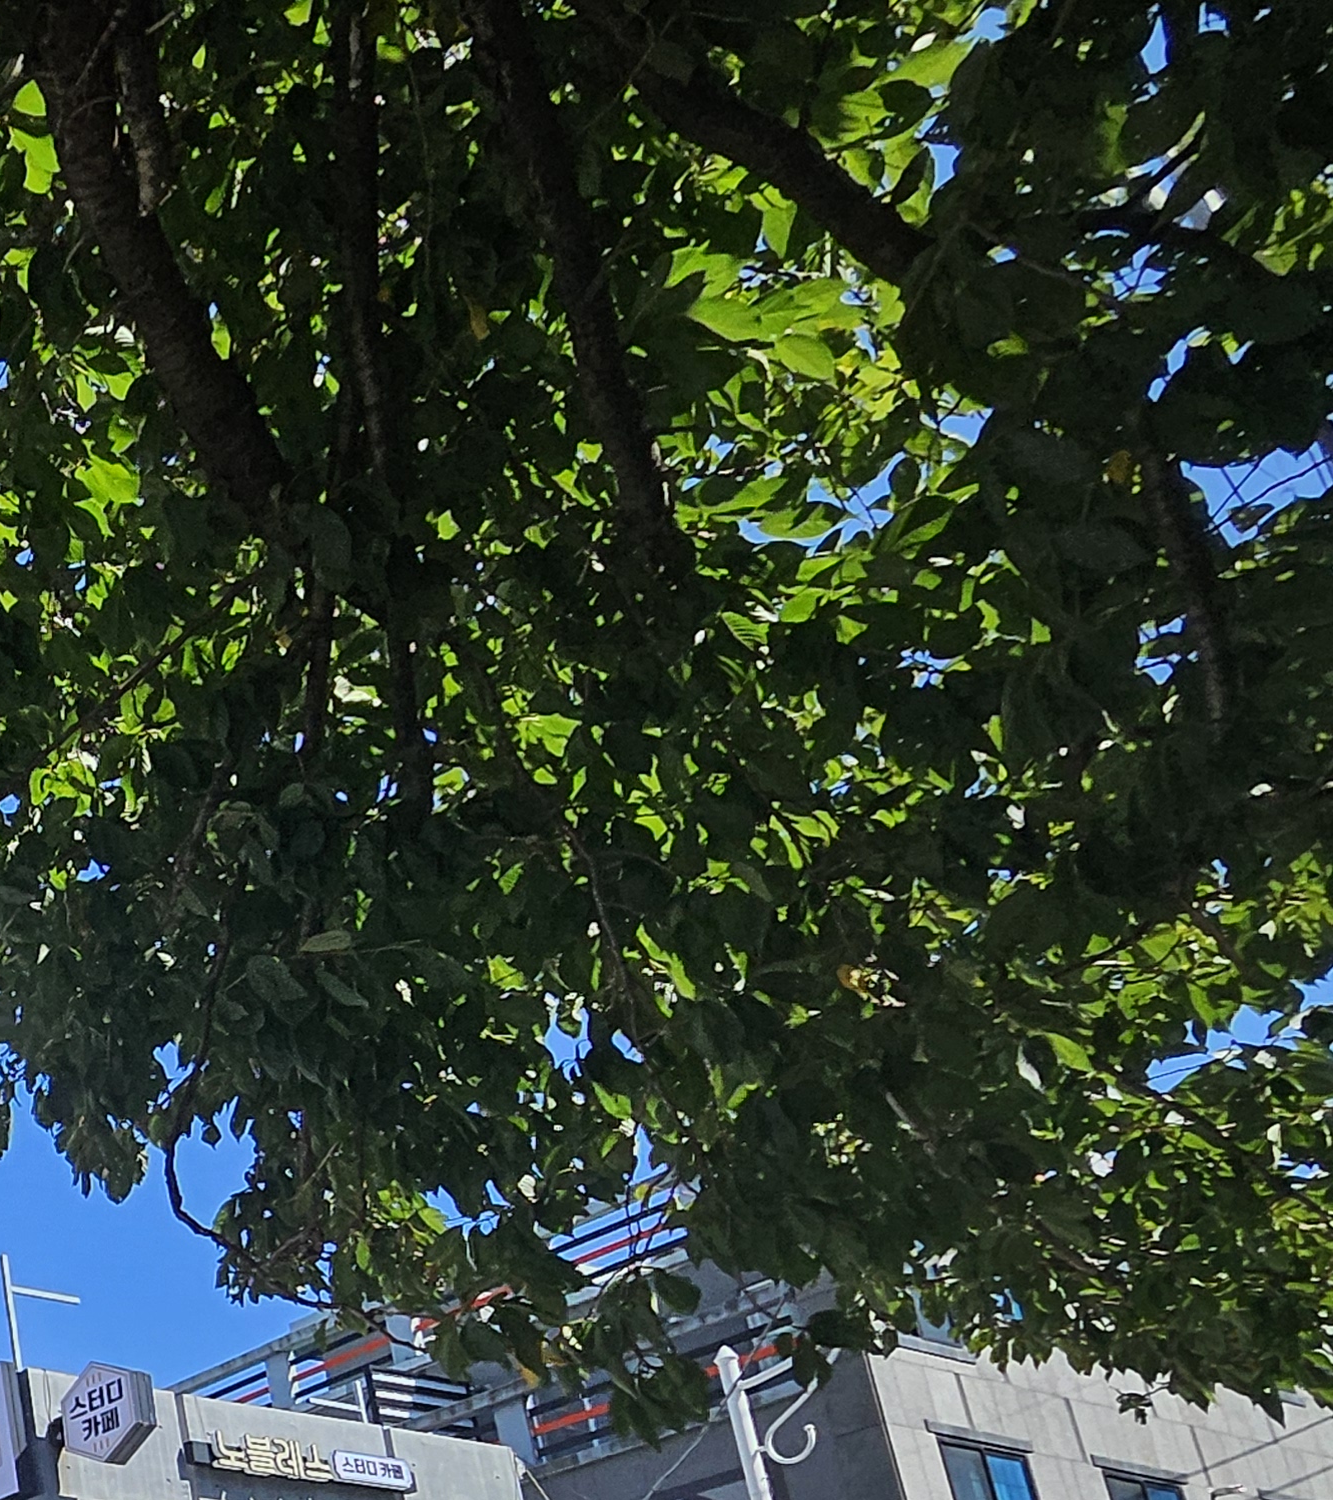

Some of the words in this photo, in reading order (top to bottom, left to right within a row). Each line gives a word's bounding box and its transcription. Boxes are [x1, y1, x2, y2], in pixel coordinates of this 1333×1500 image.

[69, 1377, 124, 1420] 스터디
[81, 1409, 121, 1441] 카페
[212, 1429, 332, 1482] 노블레스
[341, 1456, 376, 1475] 스터디
[381, 1462, 405, 1481] 카페
